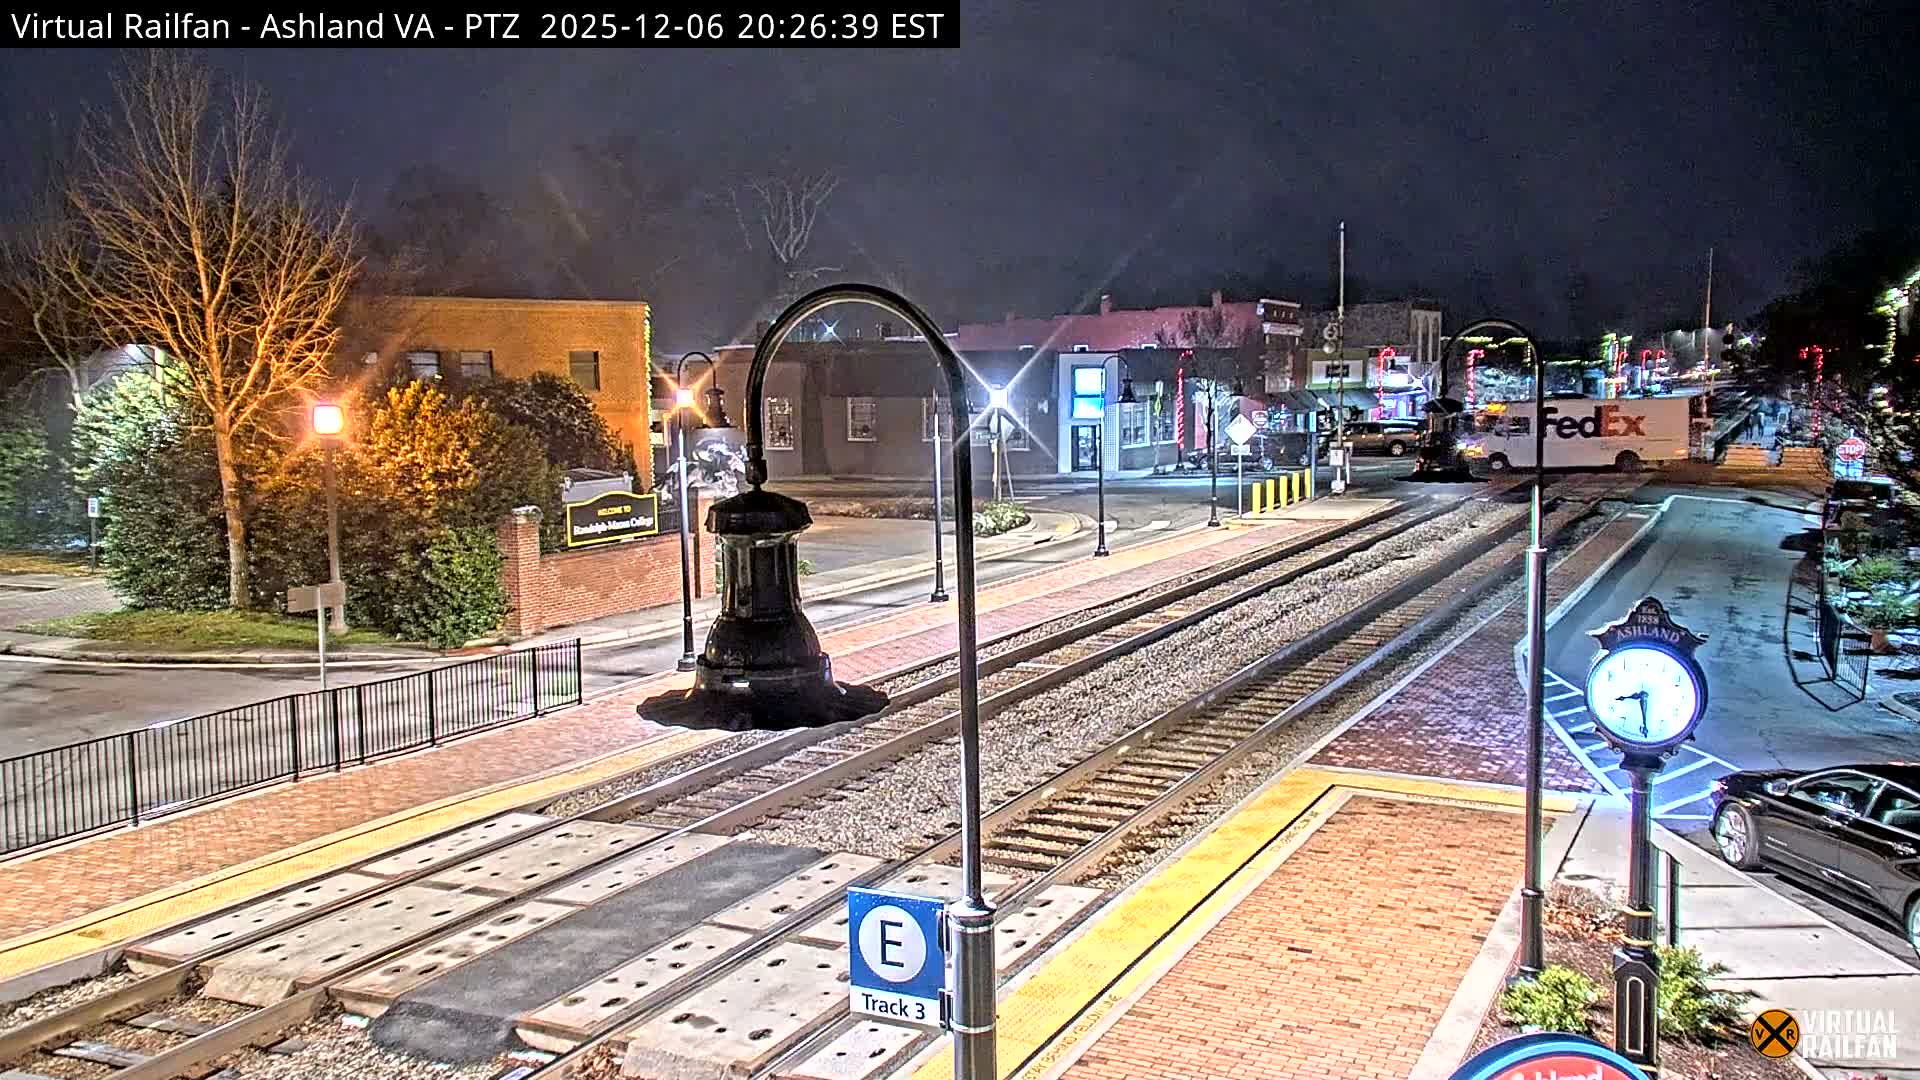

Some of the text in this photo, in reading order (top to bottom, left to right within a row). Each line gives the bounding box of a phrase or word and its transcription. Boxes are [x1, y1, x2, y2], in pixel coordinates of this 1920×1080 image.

[1542, 404, 1646, 439] FedEx
[1838, 444, 1863, 455] STOP
[1616, 625, 1680, 643] ASHLAND
[880, 919, 905, 968] E
[861, 992, 925, 1020] Track 3
